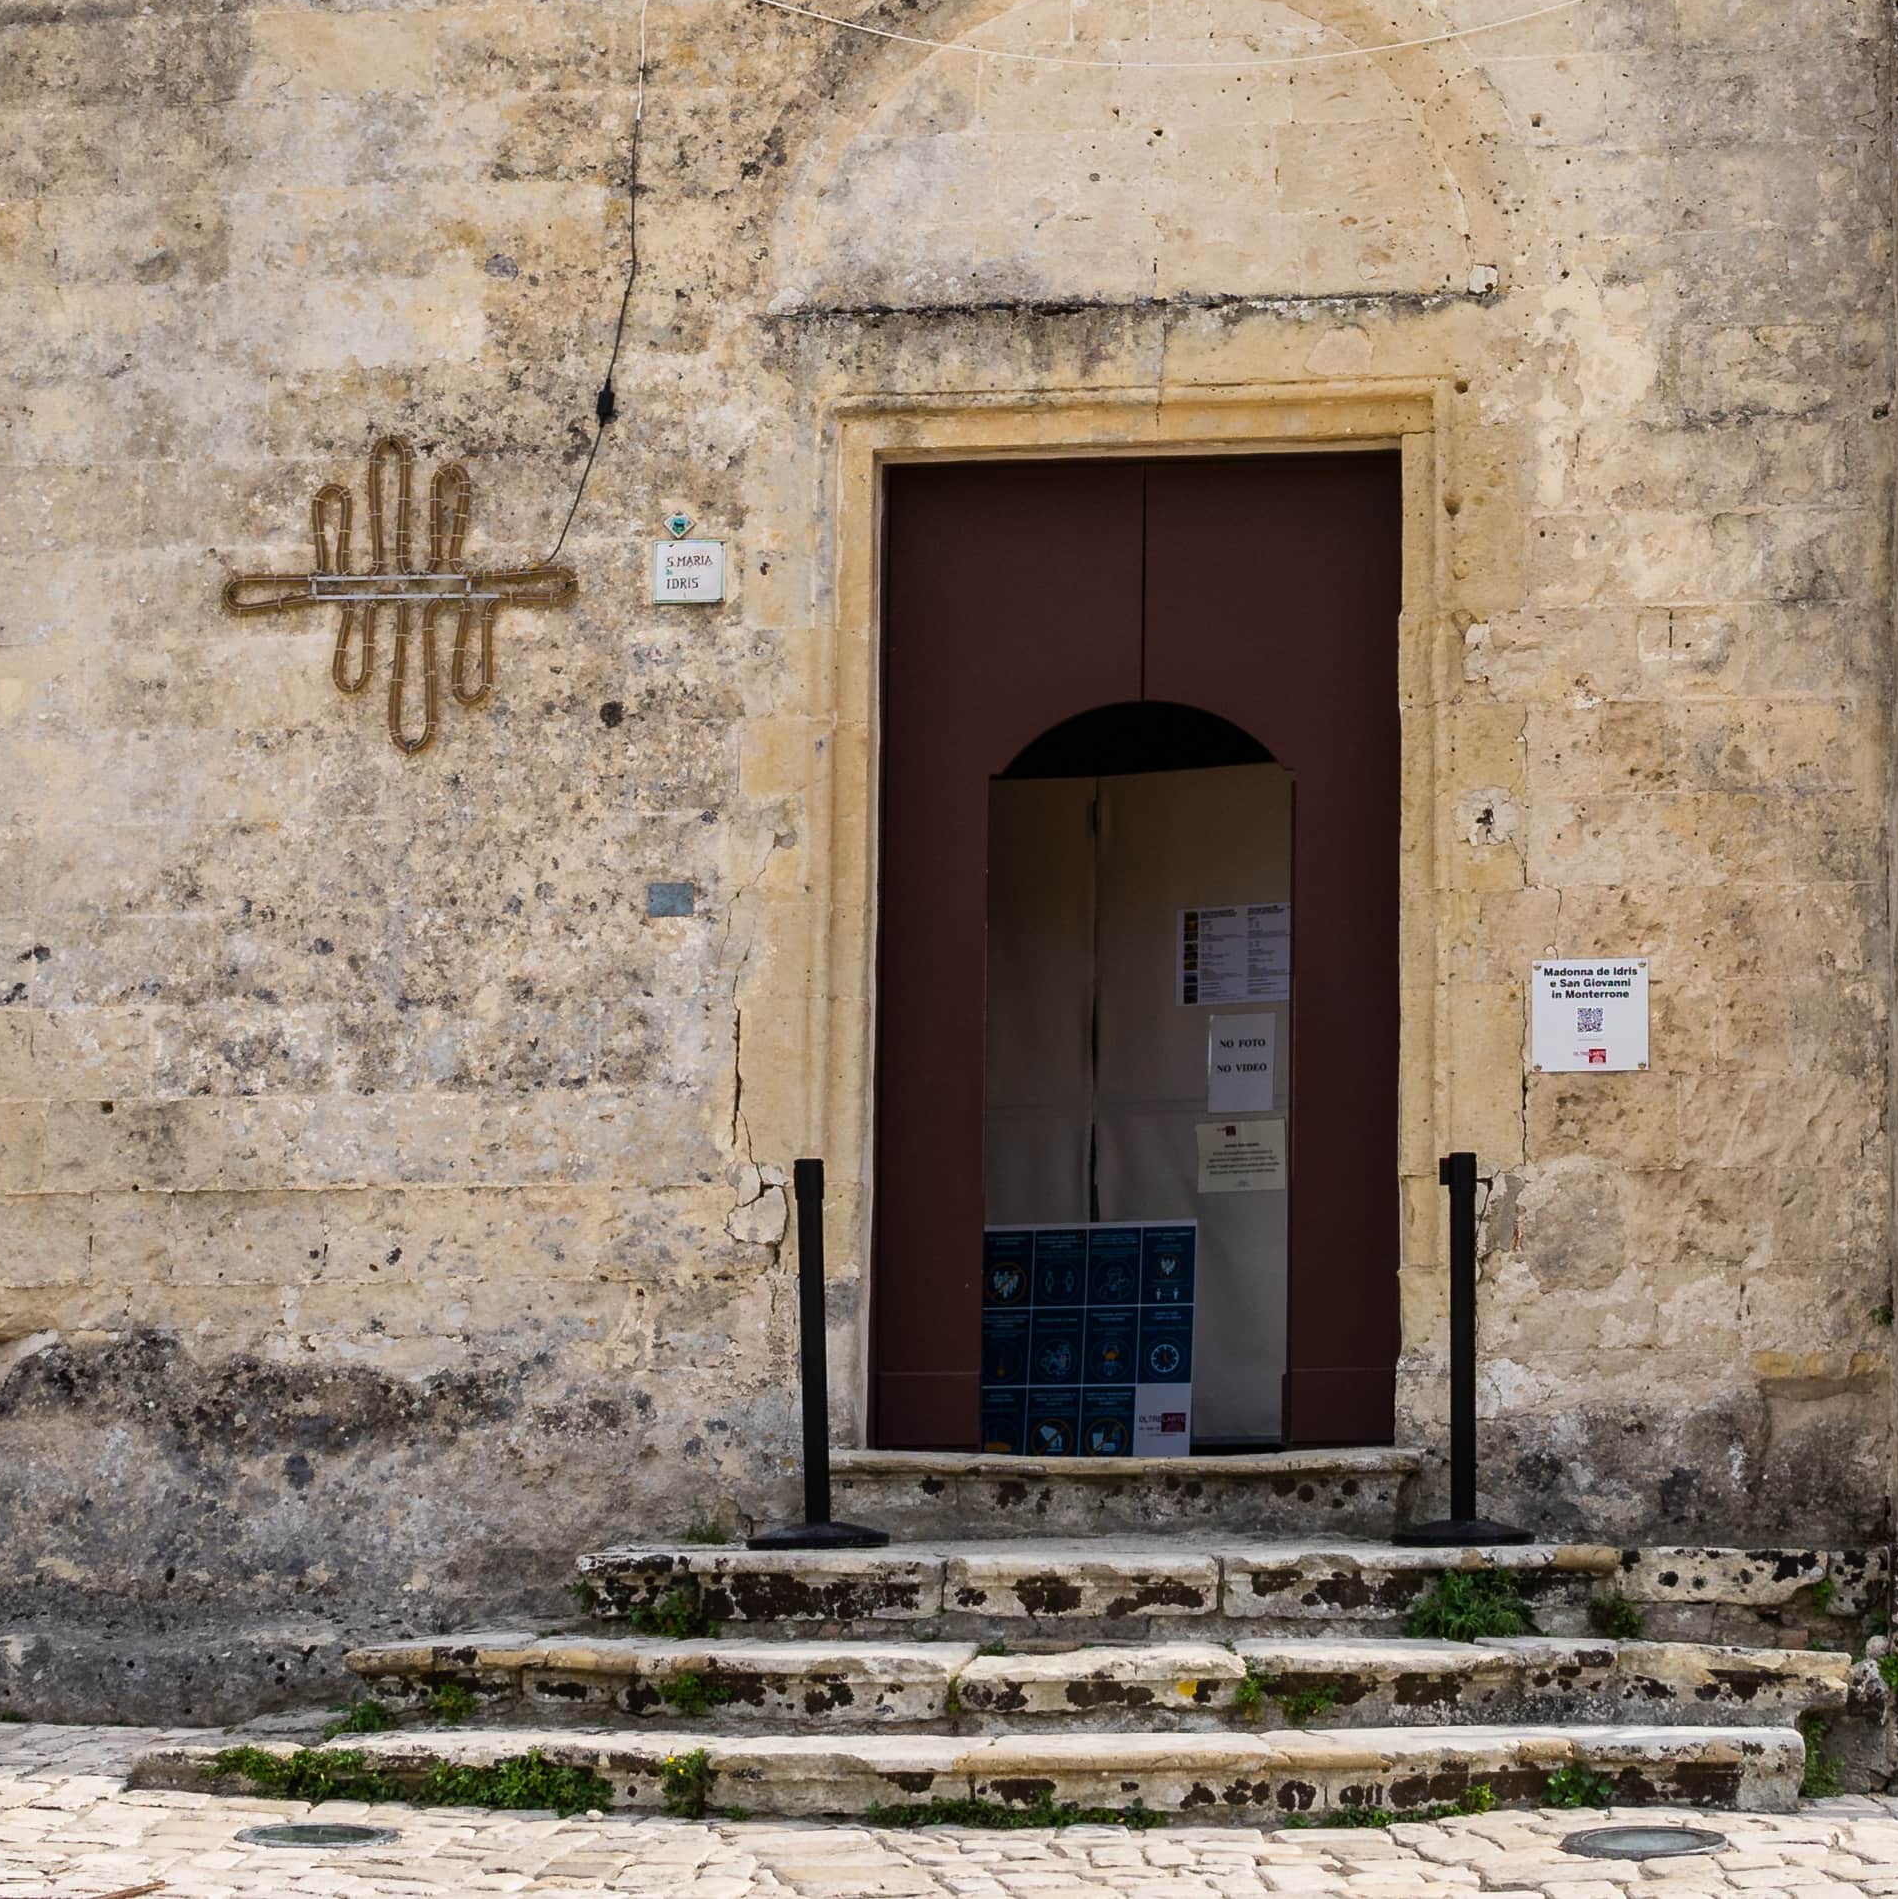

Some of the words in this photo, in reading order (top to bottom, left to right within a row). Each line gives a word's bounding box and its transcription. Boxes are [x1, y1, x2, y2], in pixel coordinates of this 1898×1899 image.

[666, 577, 699, 590] IDRIS
[1544, 967, 1594, 977] Madonna
[1596, 967, 1610, 976] de
[1613, 966, 1638, 976] Idris
[1559, 979, 1580, 988] San
[1583, 978, 1631, 988] Giovanni
[1551, 990, 1562, 999] in
[1565, 989, 1629, 999] Monterrone
[1219, 1039, 1234, 1049] NO
[1238, 1037, 1266, 1048] FOTO
[1216, 1064, 1232, 1074] NO
[1235, 1062, 1268, 1073] VIDEO
